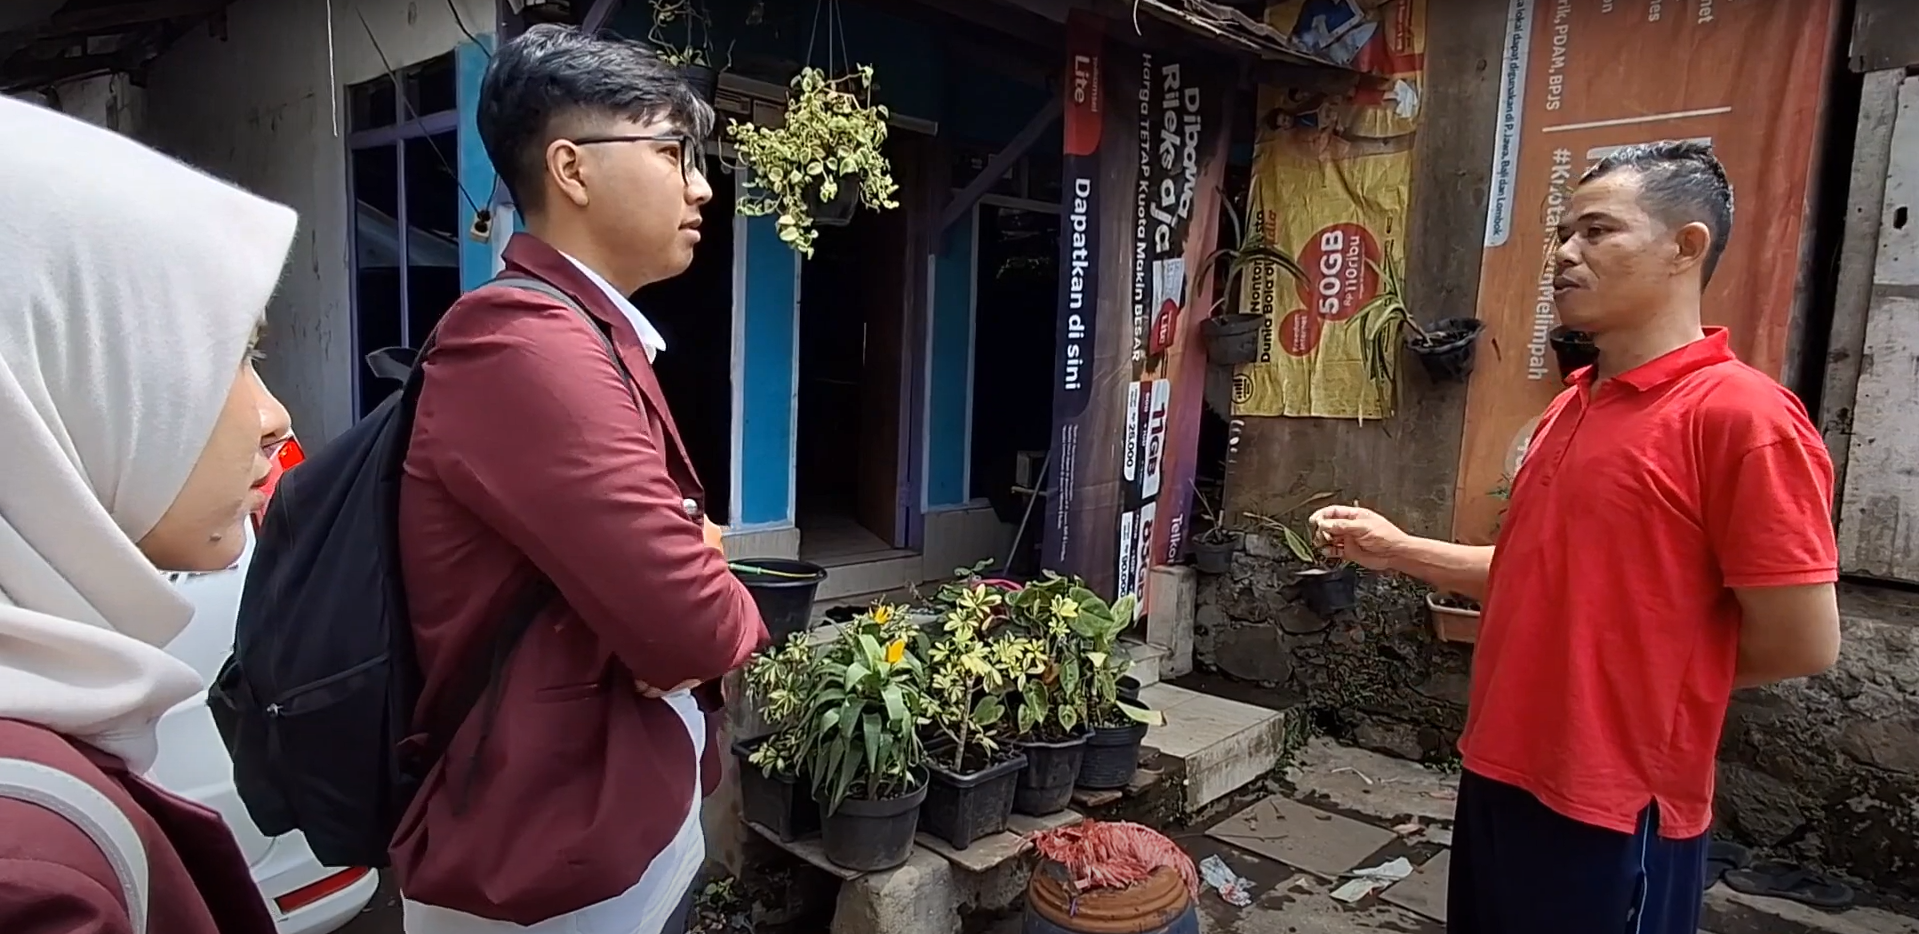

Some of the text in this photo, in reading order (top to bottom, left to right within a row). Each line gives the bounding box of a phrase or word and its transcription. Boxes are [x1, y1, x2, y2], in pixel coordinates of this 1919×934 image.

[1514, 8, 1526, 32] lokal
[1510, 33, 1523, 62] dapat
[1074, 55, 1091, 104] Lite
[1506, 62, 1519, 112] digunakan
[1546, 75, 1563, 111] BPJS
[1159, 63, 1181, 170] Rileks
[1505, 113, 1514, 123] di
[1177, 87, 1201, 220] Dibawa
[1132, 53, 1152, 362] Harga TETAP Kuota Makin BESAR
[1497, 179, 1508, 196] dan
[1150, 178, 1178, 254] aja
[1493, 197, 1507, 236] Lombok
[1065, 178, 1091, 390] Dapatkan di sini
[1318, 230, 1343, 315] 50GB
[1262, 279, 1275, 314] Bola
[1158, 314, 1169, 345] Lite
[1260, 318, 1273, 363] Dunia
[1291, 313, 1300, 353] Freedom
[1147, 403, 1166, 477] 11GB
[1167, 514, 1184, 564] Telko
